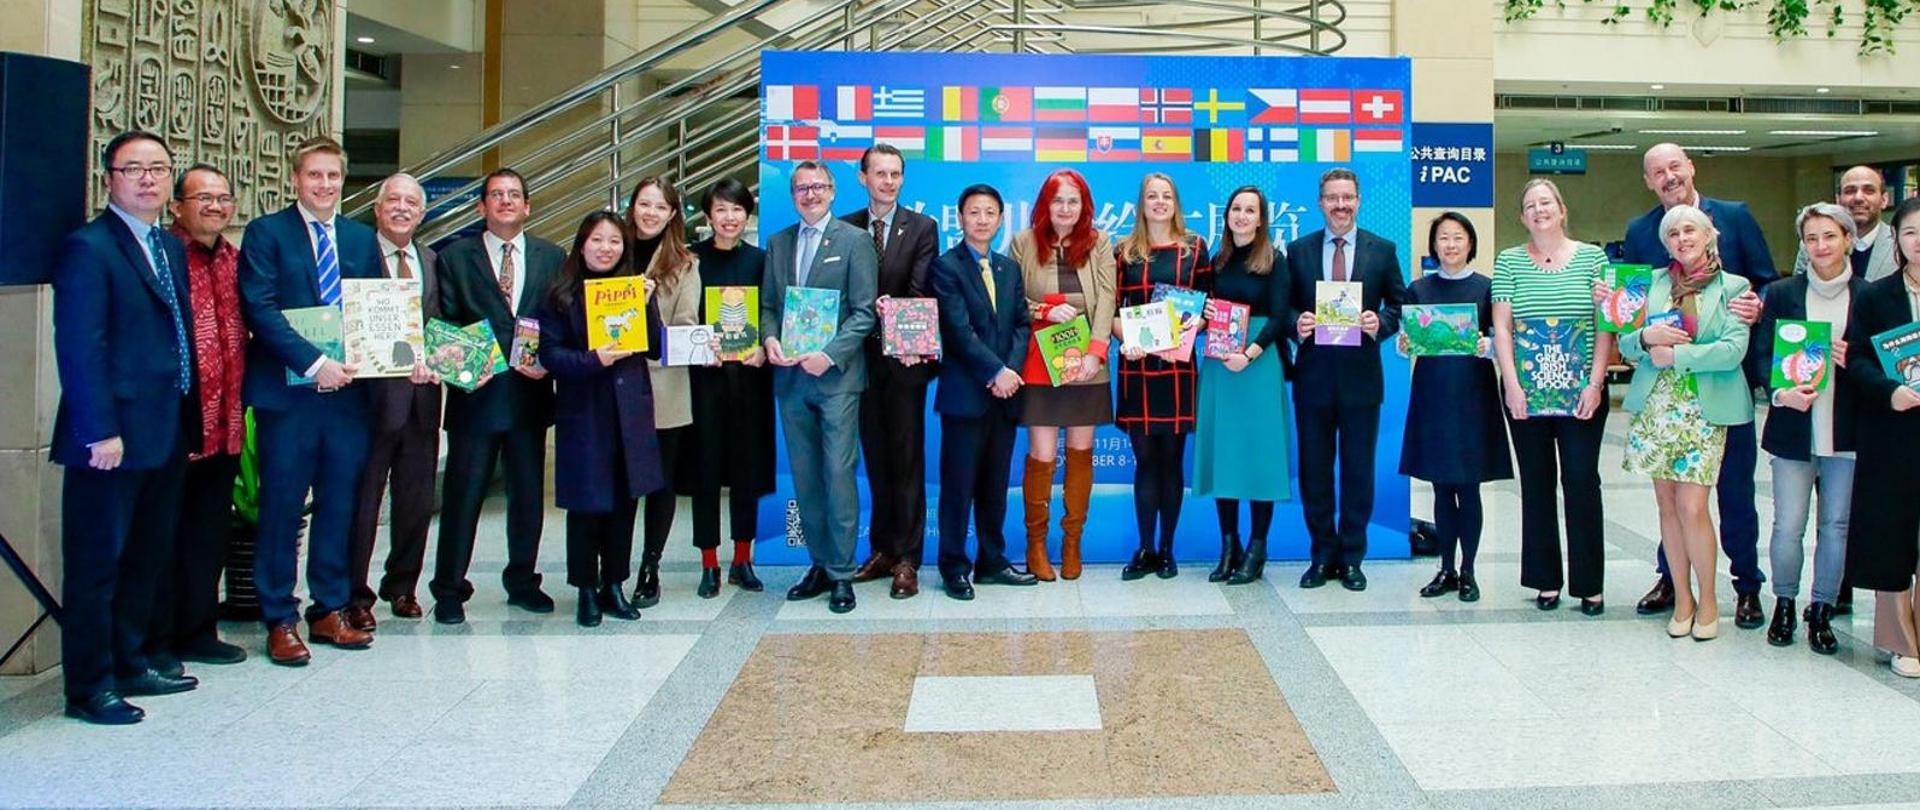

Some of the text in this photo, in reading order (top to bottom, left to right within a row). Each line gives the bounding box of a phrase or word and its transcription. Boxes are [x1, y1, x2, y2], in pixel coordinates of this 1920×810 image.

[1554, 144, 1562, 153] 3
[1411, 147, 1486, 162] 公共查询目录
[1543, 344, 1562, 354] THE
[1535, 353, 1570, 363] GREAT
[1540, 362, 1567, 372] IRISH
[1531, 371, 1573, 381] SCIENCE
[1537, 380, 1570, 390] BOOK
